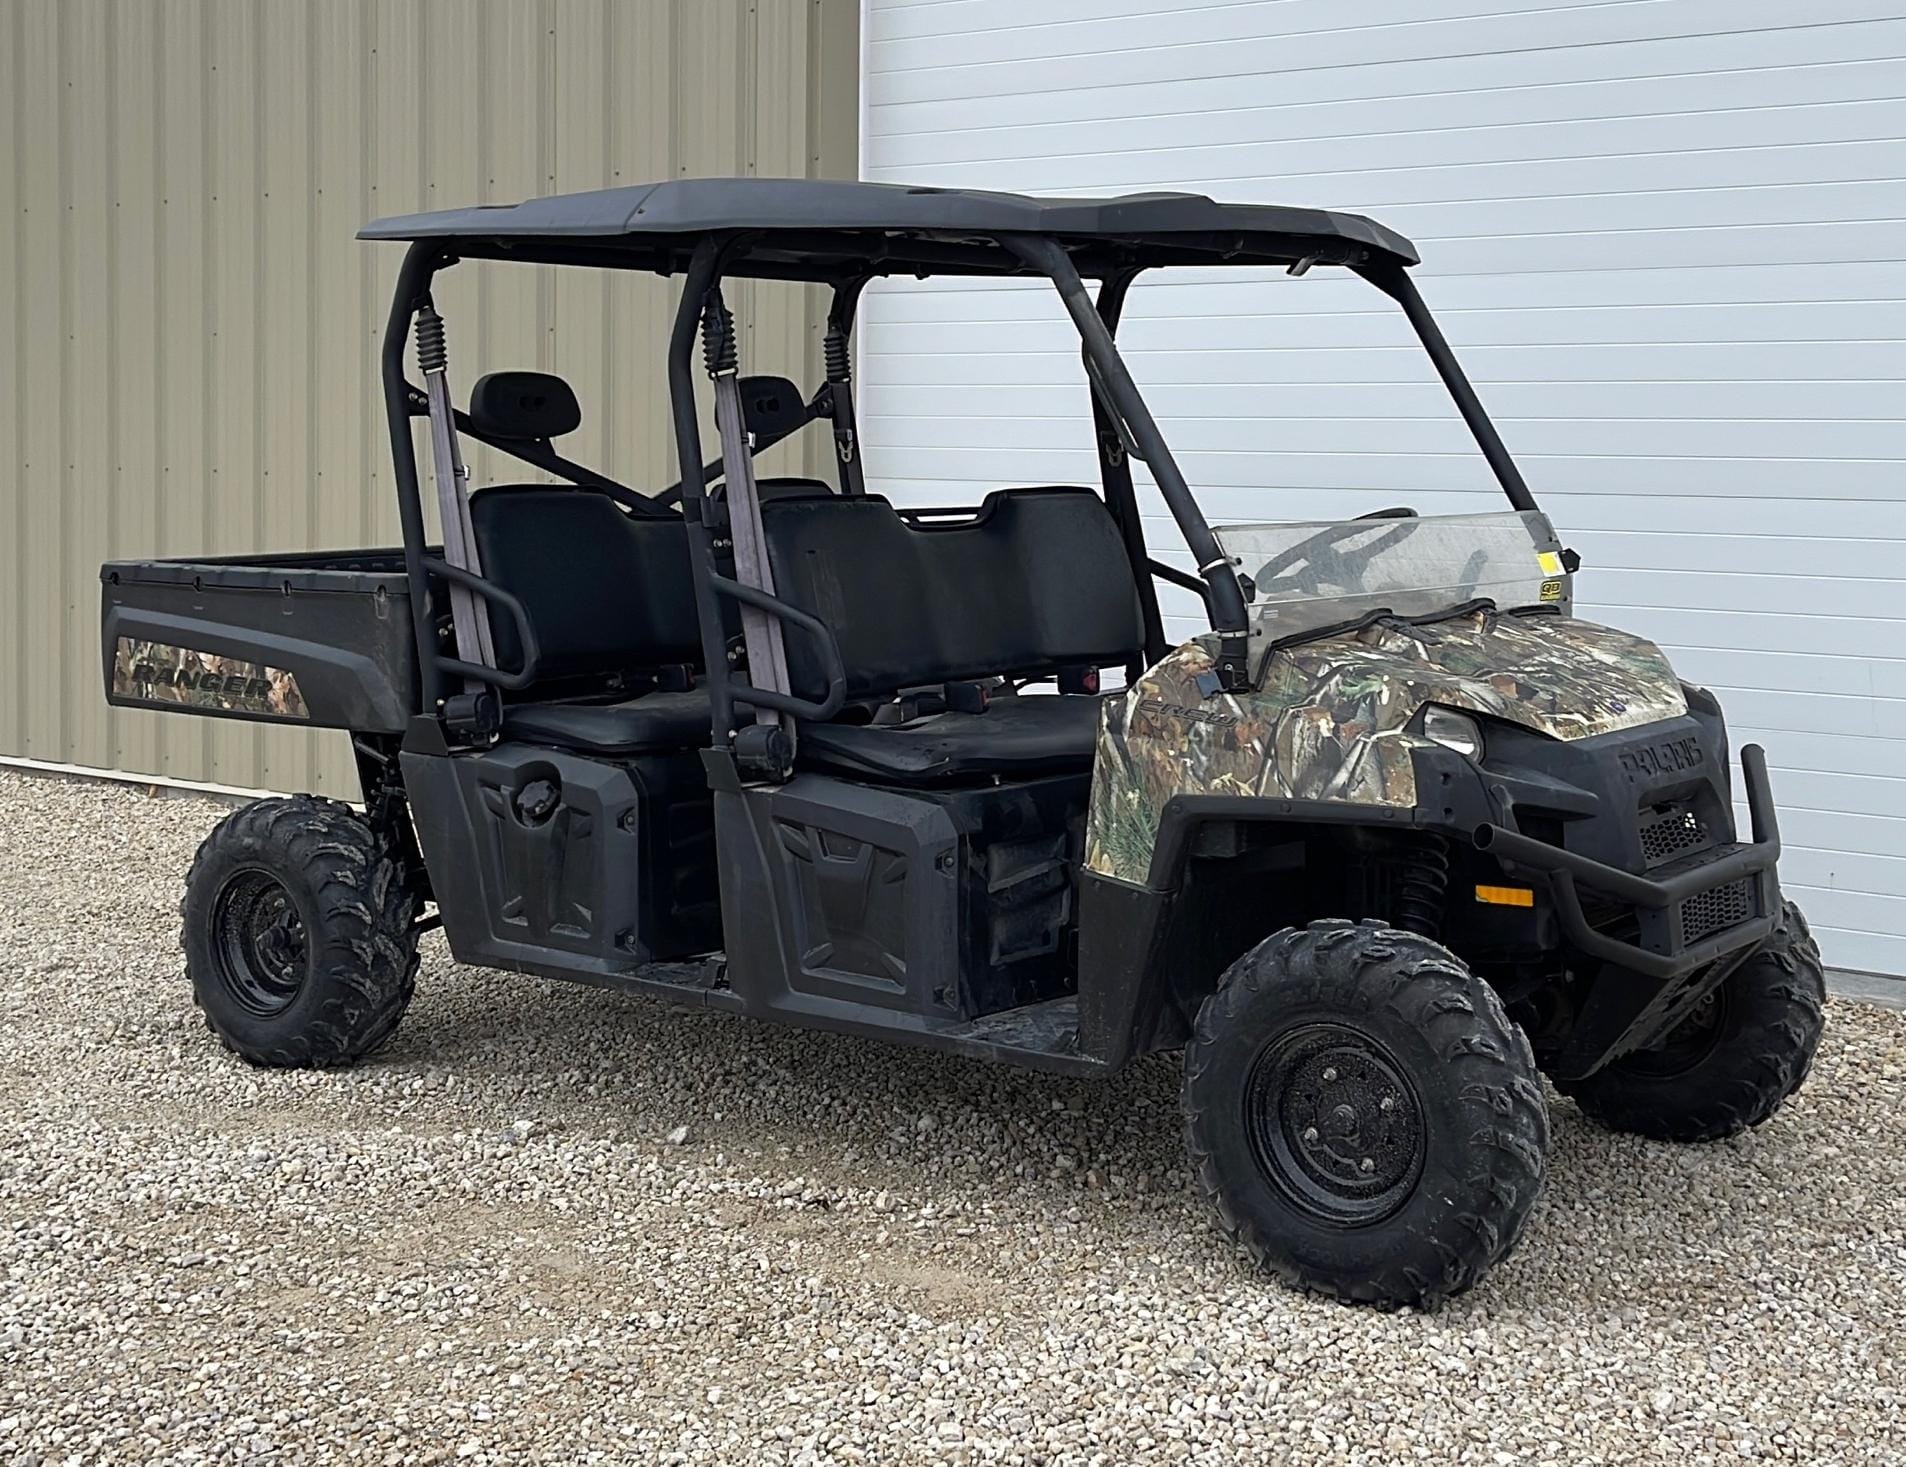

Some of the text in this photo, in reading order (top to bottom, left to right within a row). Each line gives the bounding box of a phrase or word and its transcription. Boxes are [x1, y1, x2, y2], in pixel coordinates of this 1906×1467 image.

[132, 664, 273, 697] RANGER
[1138, 700, 1238, 727] CREW
[1618, 737, 1704, 783] POLARIS
